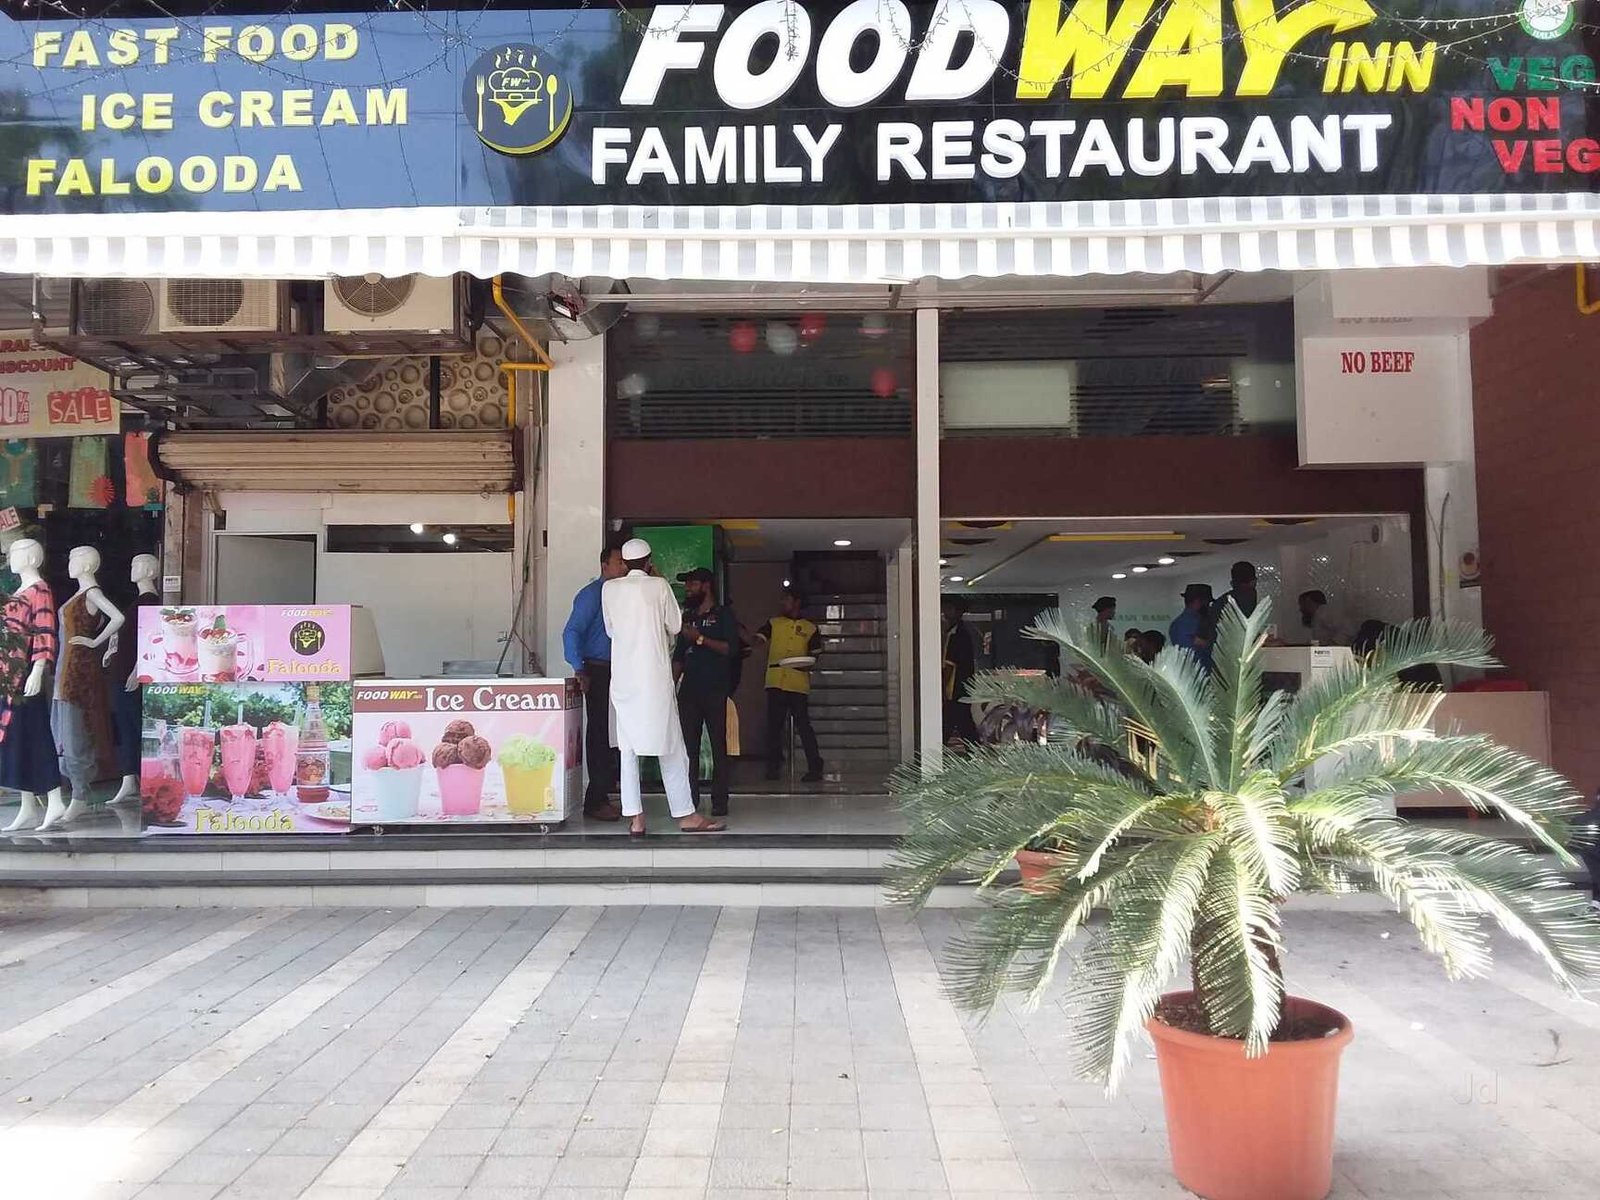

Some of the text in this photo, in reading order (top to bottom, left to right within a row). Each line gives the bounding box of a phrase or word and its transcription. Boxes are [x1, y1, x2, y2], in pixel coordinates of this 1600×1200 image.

[33, 23, 359, 68] FAST FOOD
[1322, 41, 1438, 93] INN
[1486, 54, 1596, 91] VEG
[81, 88, 409, 131] ICE CREAM
[1450, 96, 1560, 131] NON
[591, 113, 1392, 186] FAMILY RESTAURANT
[1491, 137, 1600, 174] VEG
[26, 154, 304, 197] FALOODA
[0, 357, 76, 374] ISCOUNT
[1341, 351, 1415, 373] NO BEEF
[50, 392, 111, 424] SALE
[0, 508, 19, 529] ALE
[268, 658, 342, 675] Falooda
[425, 687, 465, 711] Ice
[473, 686, 561, 711] Cream
[194, 808, 296, 833] Falooda
